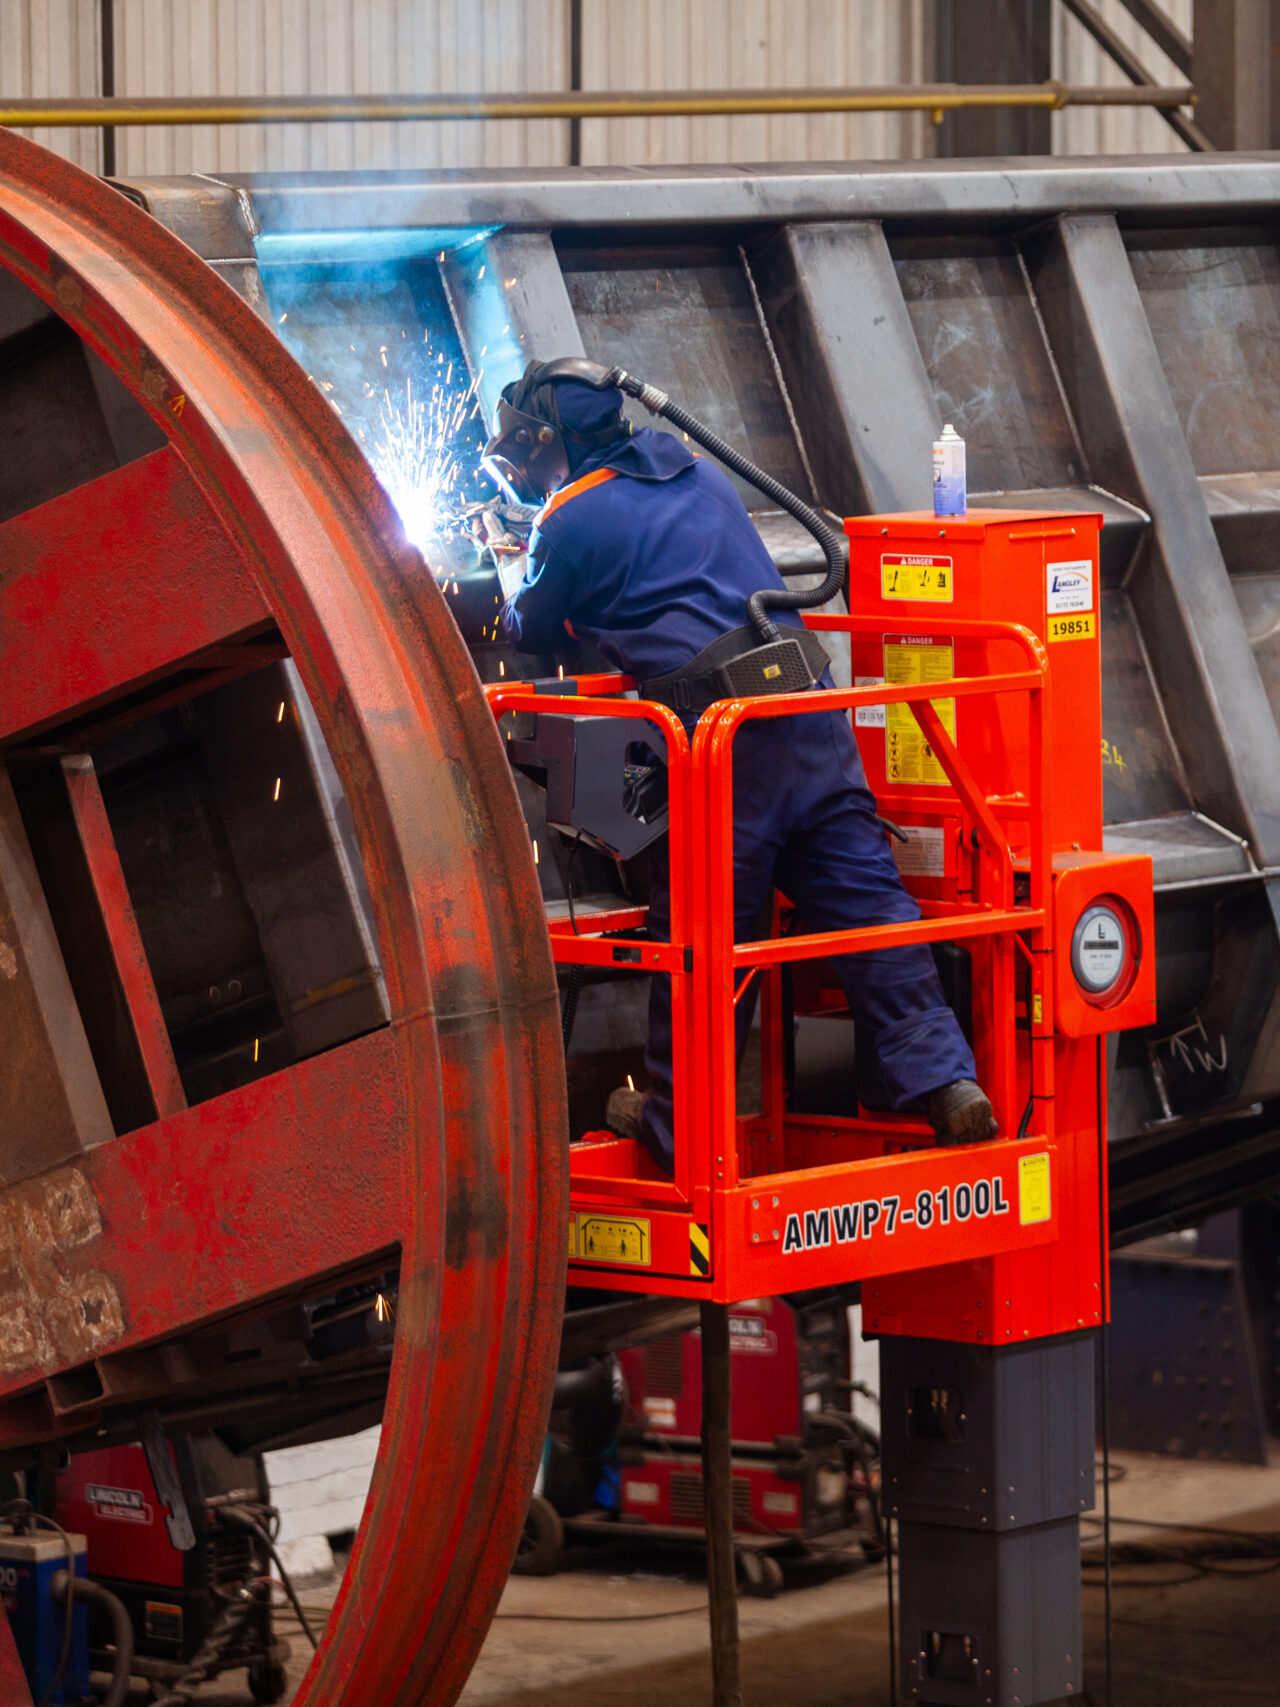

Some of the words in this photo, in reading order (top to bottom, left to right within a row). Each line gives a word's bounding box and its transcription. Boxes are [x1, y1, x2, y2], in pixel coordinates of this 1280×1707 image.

[907, 557, 934, 566] DANGER
[1051, 575, 1081, 593] LANGLEY
[1053, 620, 1090, 636] 19851
[907, 636, 933, 645] DANGER
[782, 1176, 1011, 1254] AMWP7-8100L
[88, 1485, 142, 1508] LINCOLN
